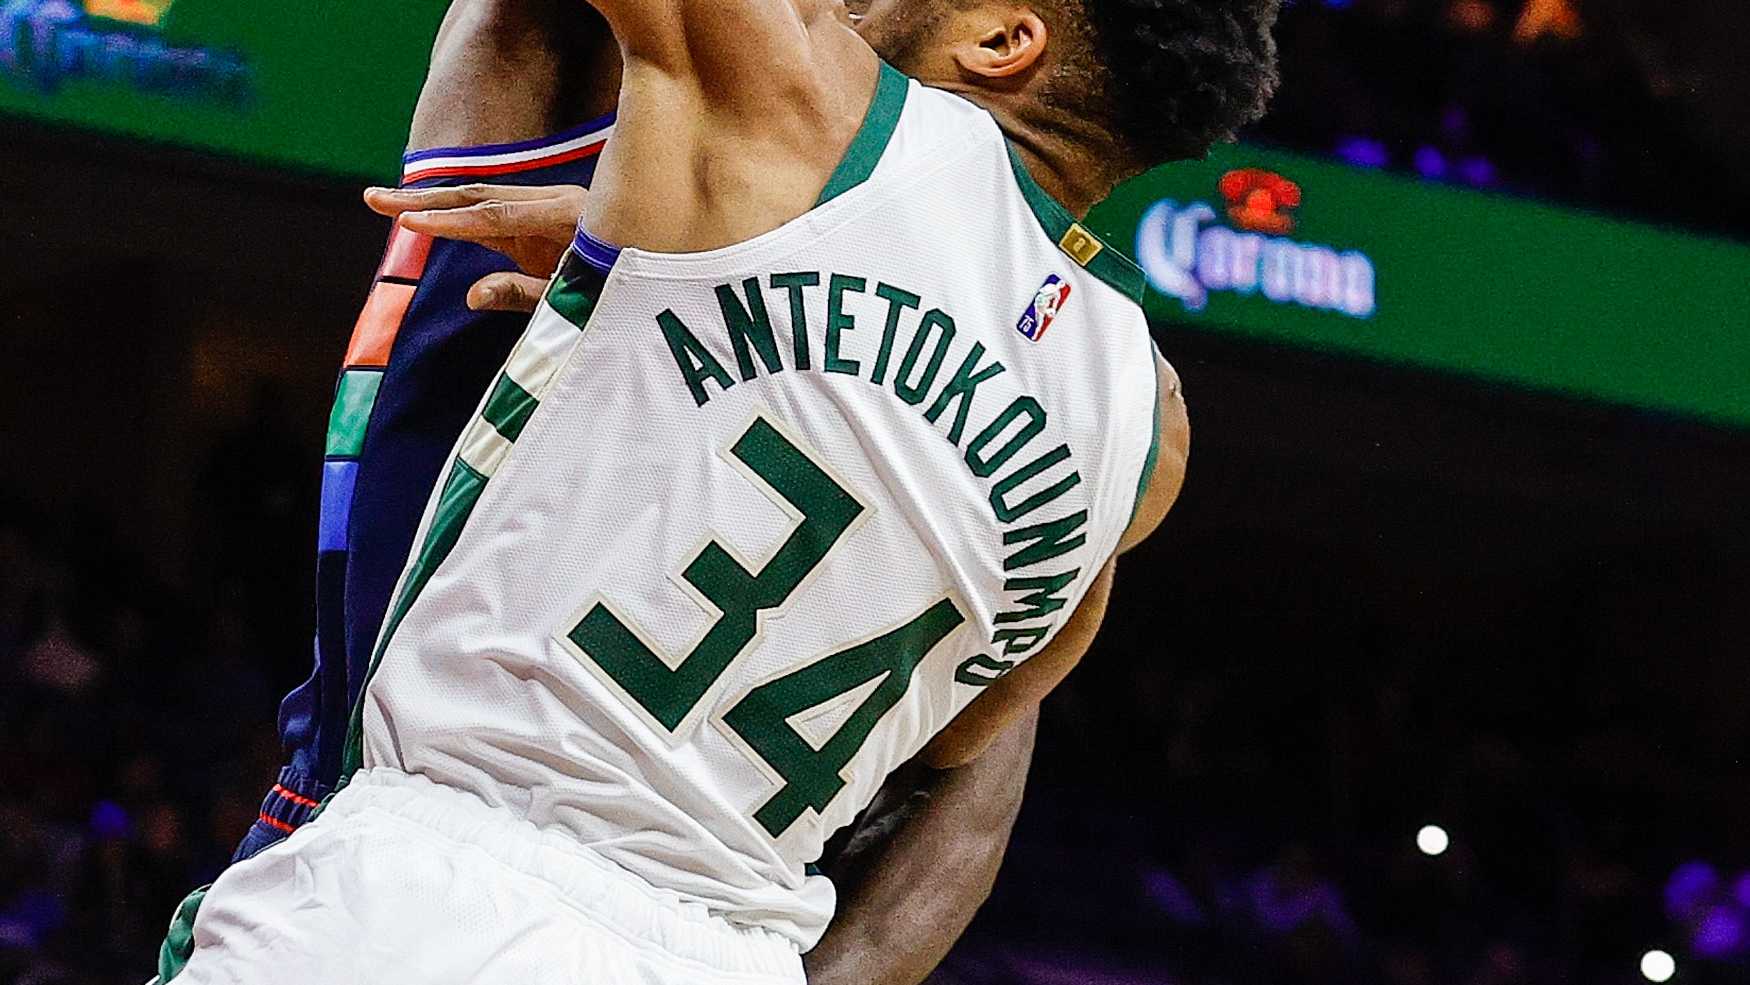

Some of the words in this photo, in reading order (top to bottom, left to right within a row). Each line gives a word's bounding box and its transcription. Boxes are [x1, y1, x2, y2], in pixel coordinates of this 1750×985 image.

[1018, 314, 1035, 333] 75
[1136, 198, 1375, 319] Corona
[655, 271, 1088, 687] ANTETOKOUNMPO
[560, 407, 972, 842] 34
